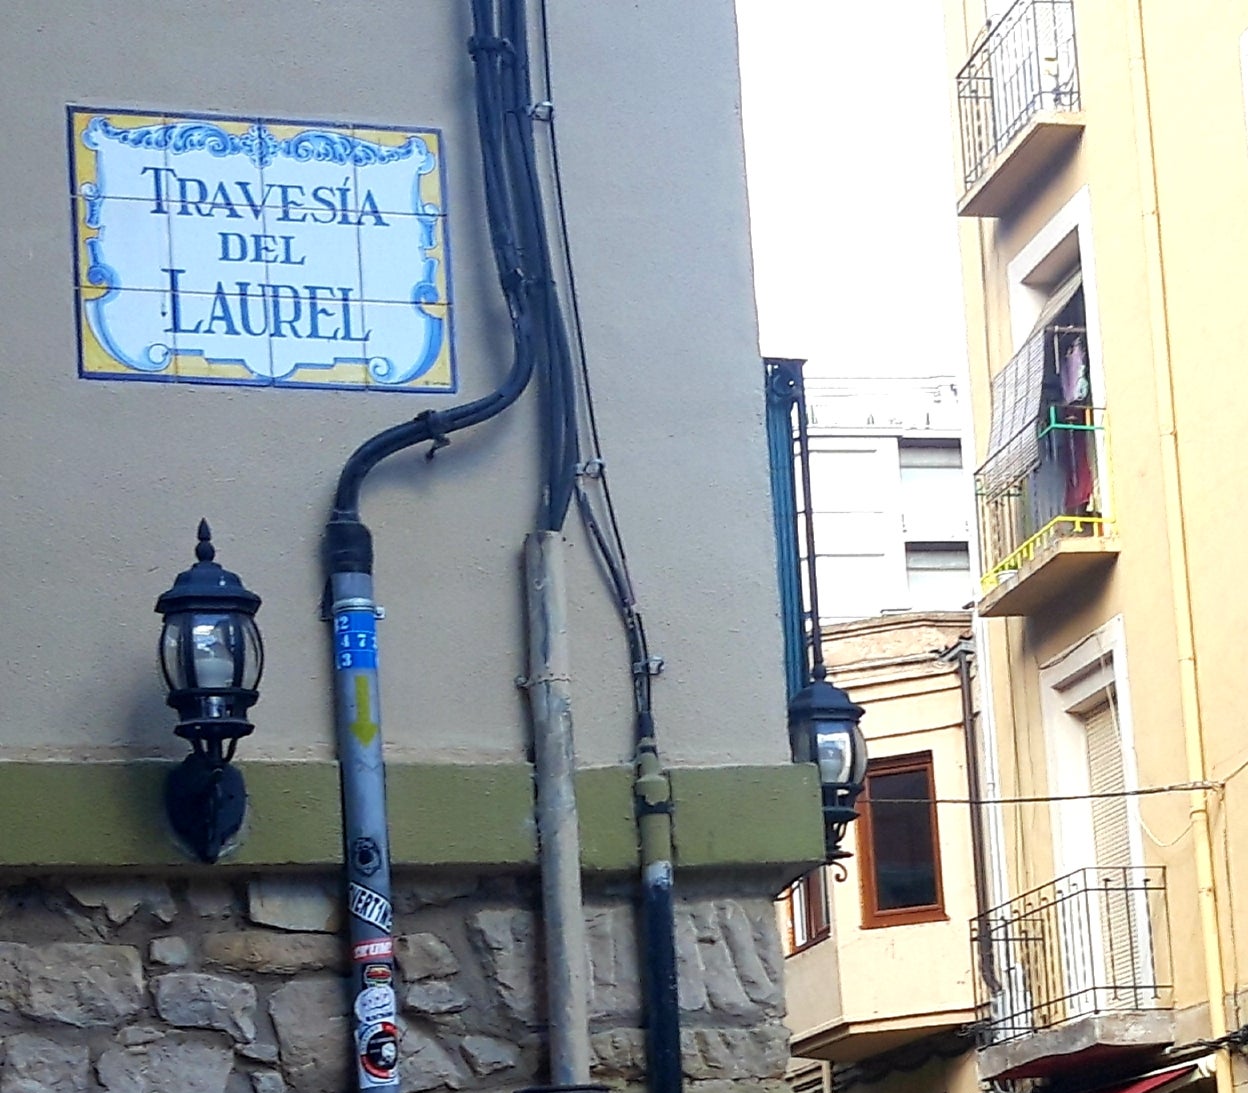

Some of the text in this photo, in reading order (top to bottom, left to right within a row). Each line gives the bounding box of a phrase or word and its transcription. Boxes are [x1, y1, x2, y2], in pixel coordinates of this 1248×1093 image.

[141, 167, 390, 226] TRAVESÍA
[218, 232, 306, 265] DEL
[161, 268, 372, 342] LAUREL
